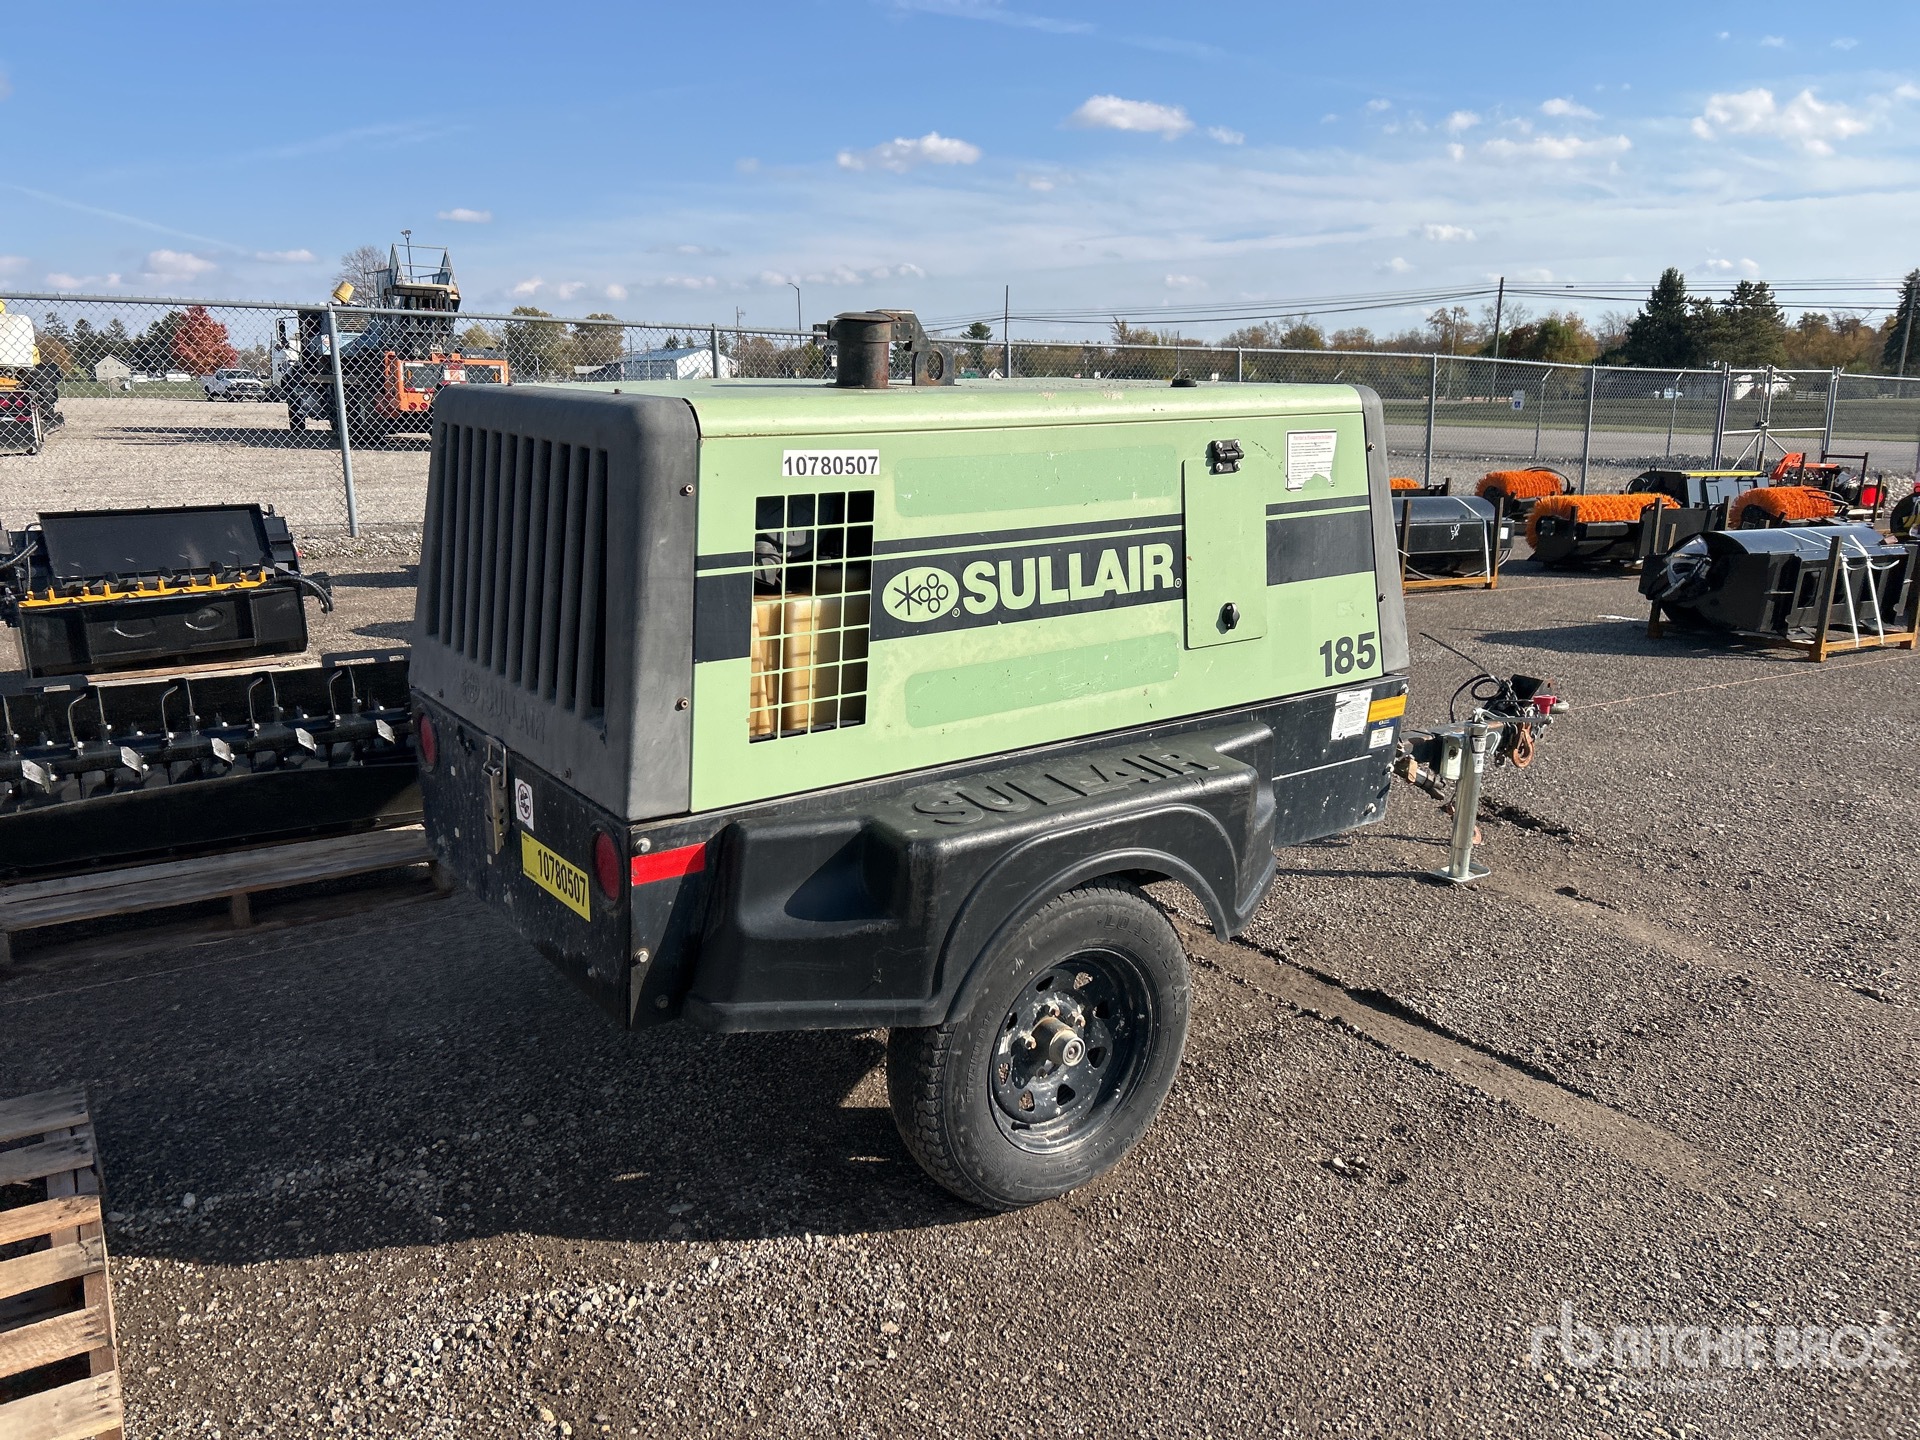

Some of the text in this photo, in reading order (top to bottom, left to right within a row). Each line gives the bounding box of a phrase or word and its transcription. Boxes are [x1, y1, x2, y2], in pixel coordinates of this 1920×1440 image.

[784, 456, 879, 476] 10780507
[962, 543, 1175, 615] SULLAIR
[1319, 631, 1376, 678] 185
[911, 753, 1221, 826] SULLAIR
[537, 848, 586, 907] 10780507
